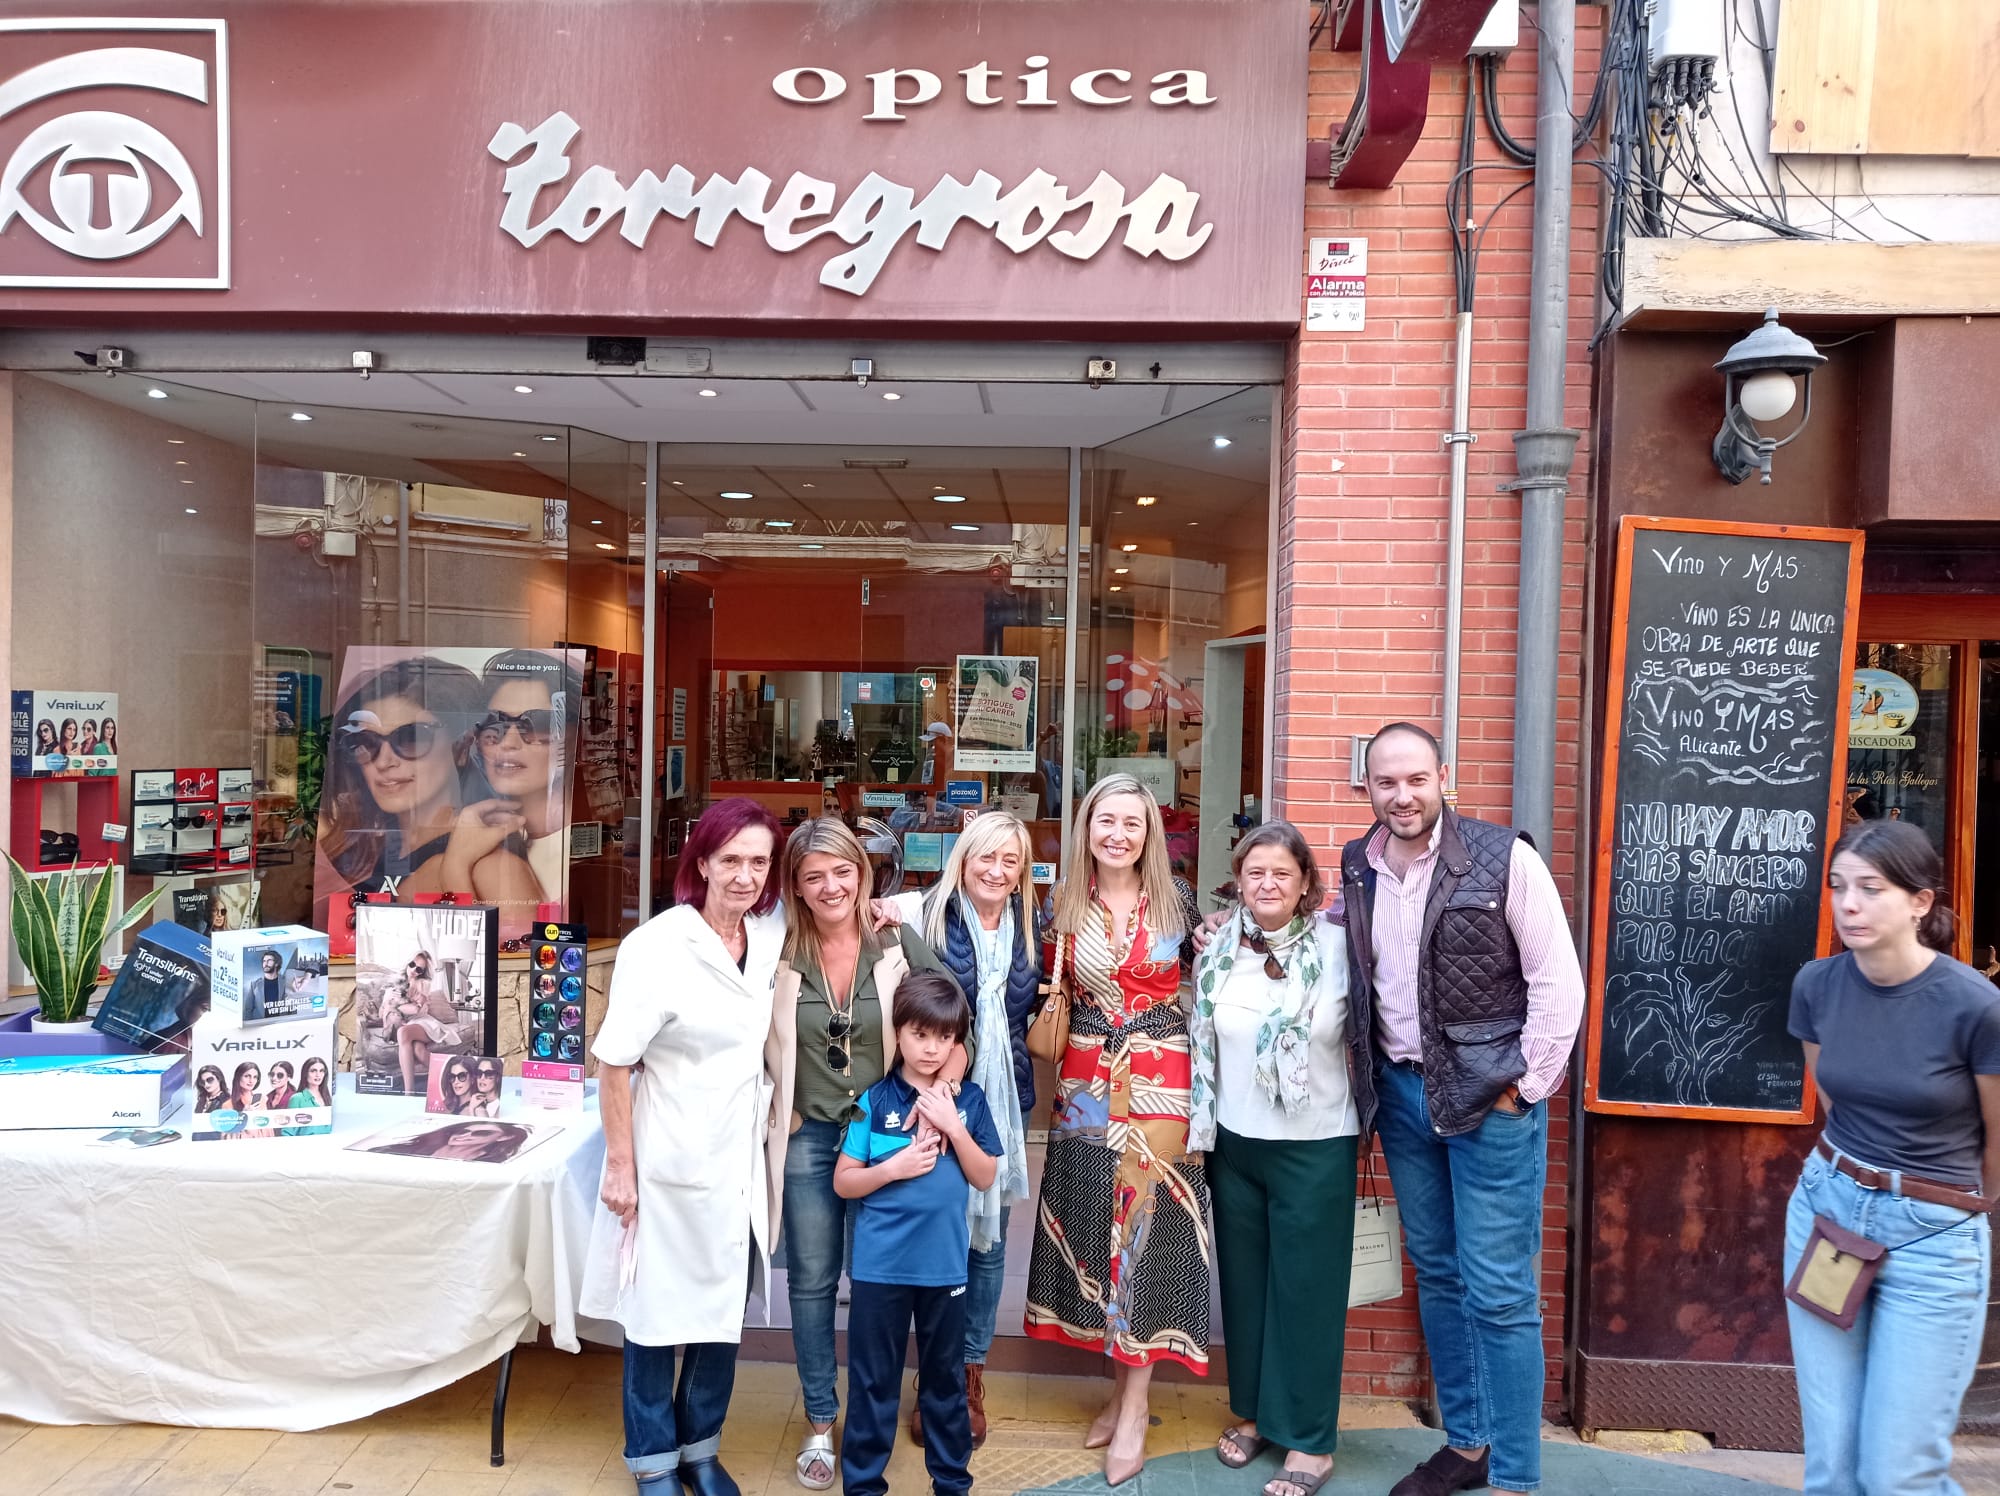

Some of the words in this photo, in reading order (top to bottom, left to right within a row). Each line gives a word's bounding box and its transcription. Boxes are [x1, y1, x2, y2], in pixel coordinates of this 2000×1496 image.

[772, 55, 1218, 122] optica
[488, 111, 1214, 296] torregrosa
[1310, 277, 1365, 290] Alarma
[1718, 555, 1733, 577] Y
[1727, 604, 1752, 628] ES
[1758, 607, 1781, 630] LA
[1789, 609, 1837, 635] UNICA
[1642, 626, 1692, 654] OBRA
[1698, 634, 1724, 653] DE
[1726, 636, 1779, 658] ARTE
[1784, 637, 1821, 659] QUE
[496, 663, 515, 671] Nice
[542, 664, 561, 673] you.
[1640, 660, 1671, 678] SE
[1672, 657, 1732, 678] PUEDE
[1738, 660, 1809, 677] BEBER
[46, 698, 107, 711] VARILUX
[986, 707, 1016, 718] CARRER
[1736, 702, 1795, 754] MAS
[1679, 735, 1742, 757] Alicante
[1857, 772, 1869, 785] las
[1898, 770, 1938, 791] Gallegas
[1622, 802, 1668, 846] NO
[1671, 803, 1734, 848] HAY
[1730, 808, 1817, 853] AMOR
[1615, 880, 1676, 919] QUE
[1686, 885, 1722, 922] EL
[432, 914, 482, 941] HIDE
[1615, 920, 1677, 963] POR
[1680, 927, 1720, 965] LA
[133, 960, 151, 972] light
[137, 946, 198, 982] Transitions
[141, 972, 164, 985] control
[210, 1034, 310, 1052] VARILUX
